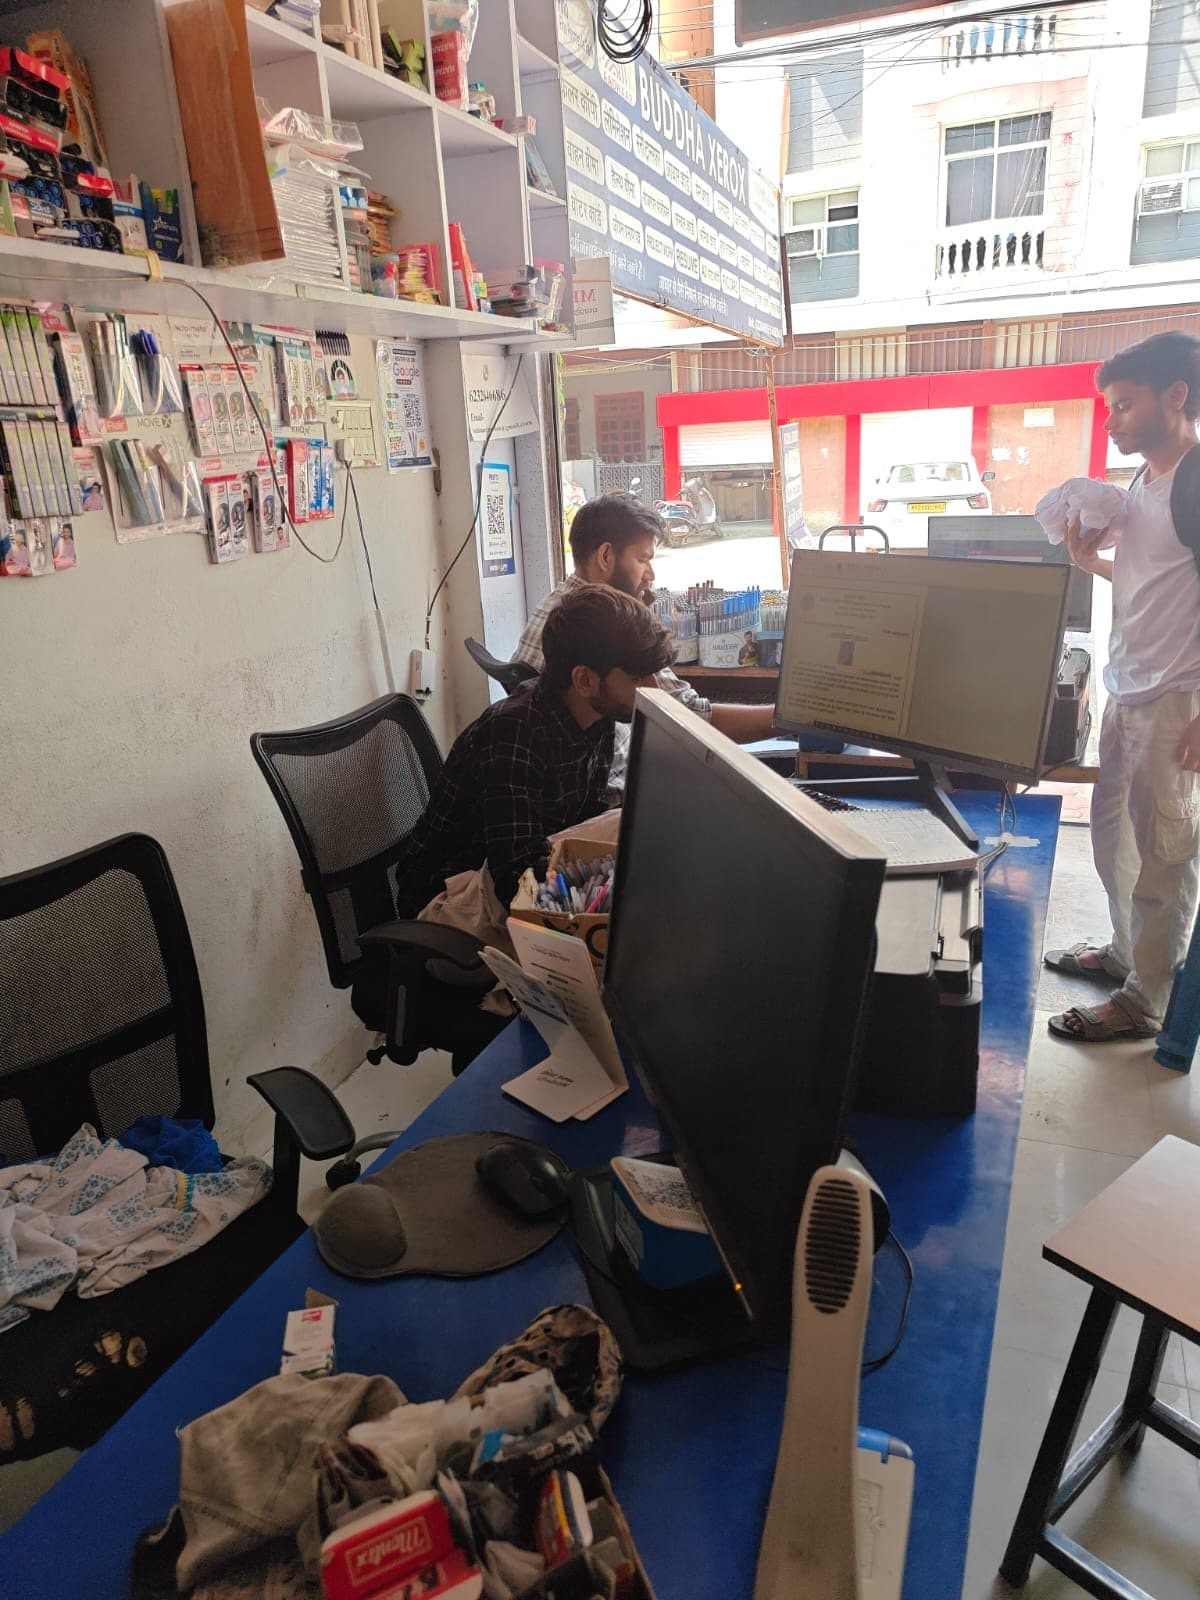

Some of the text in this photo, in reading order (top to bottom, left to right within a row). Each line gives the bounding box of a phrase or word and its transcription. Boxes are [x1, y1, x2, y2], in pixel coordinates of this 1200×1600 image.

[639, 68, 706, 168] BUDDHA
[707, 133, 747, 204] XEROX
[675, 248, 698, 273] RESUME
[392, 362, 420, 381] Google
